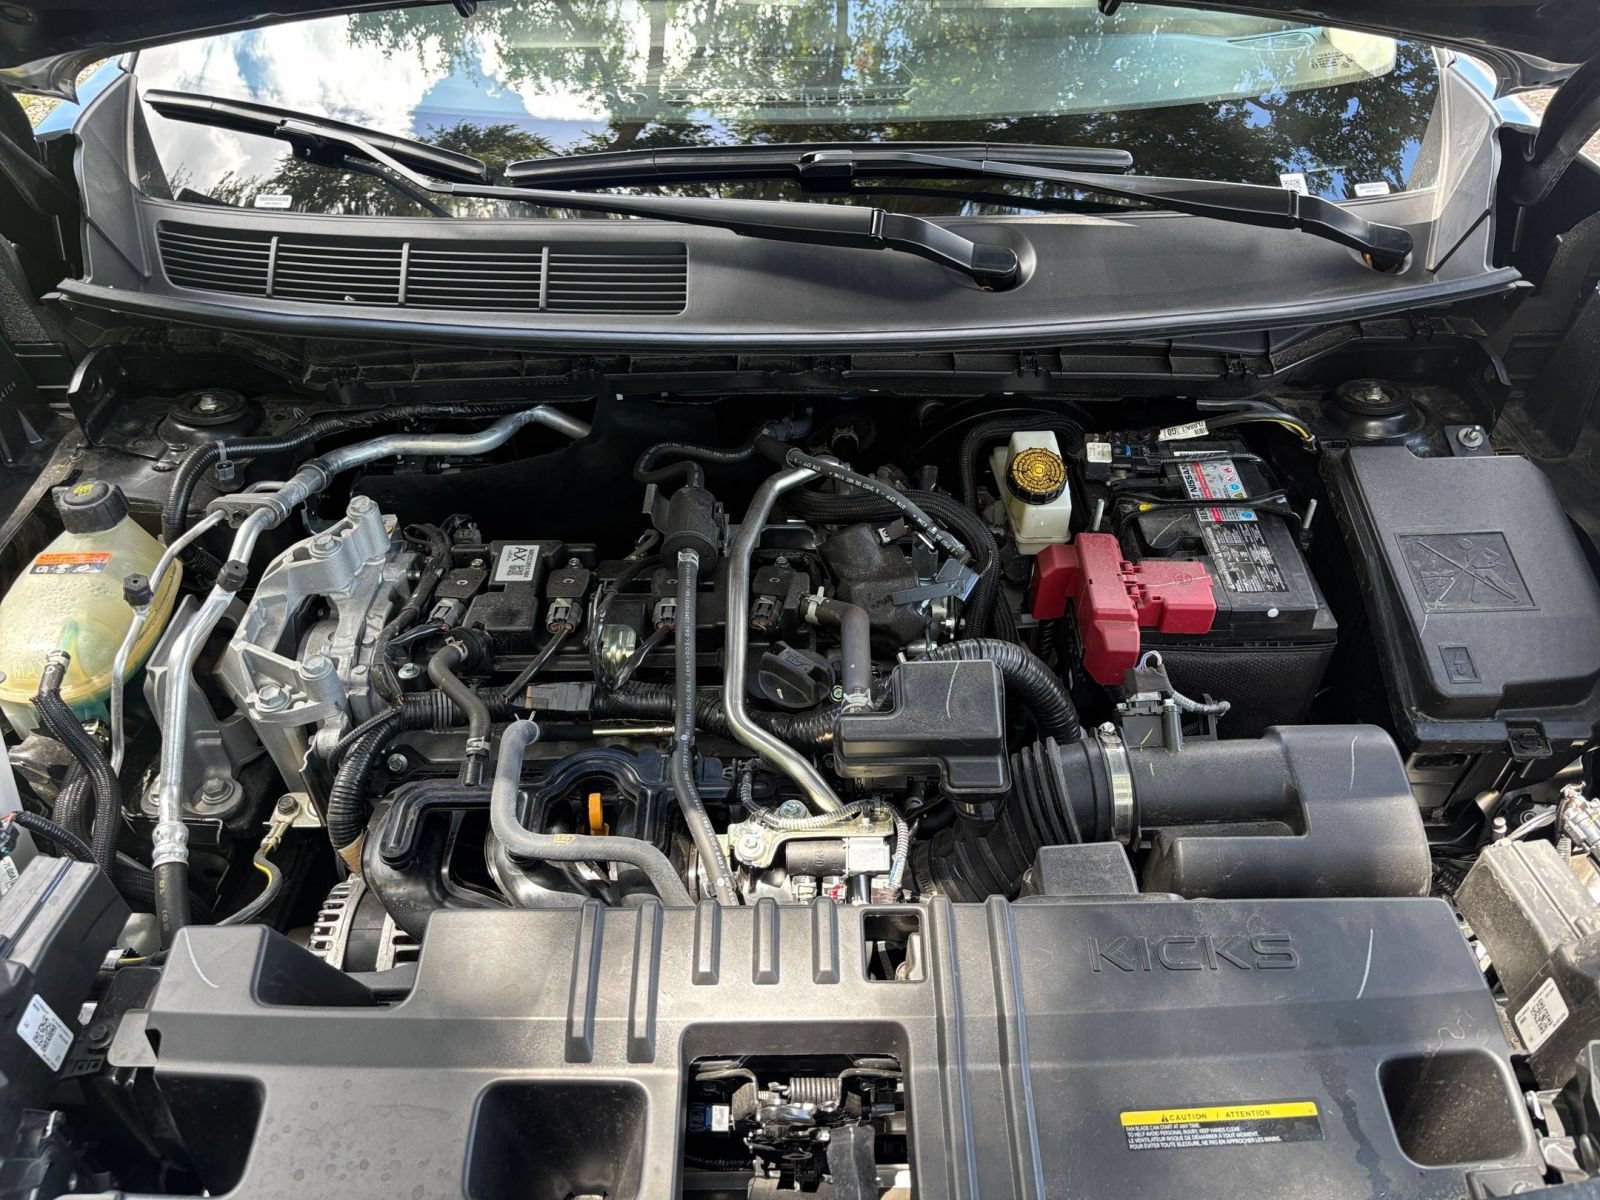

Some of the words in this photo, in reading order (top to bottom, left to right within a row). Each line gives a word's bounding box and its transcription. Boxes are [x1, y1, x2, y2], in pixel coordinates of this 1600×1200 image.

[1181, 465, 1198, 493] NISSAN
[512, 547, 528, 561] AX
[1088, 935, 1299, 972] KICKS
[1169, 1112, 1207, 1121] CAUTION
[1225, 1110, 1271, 1118] ATTENTION
